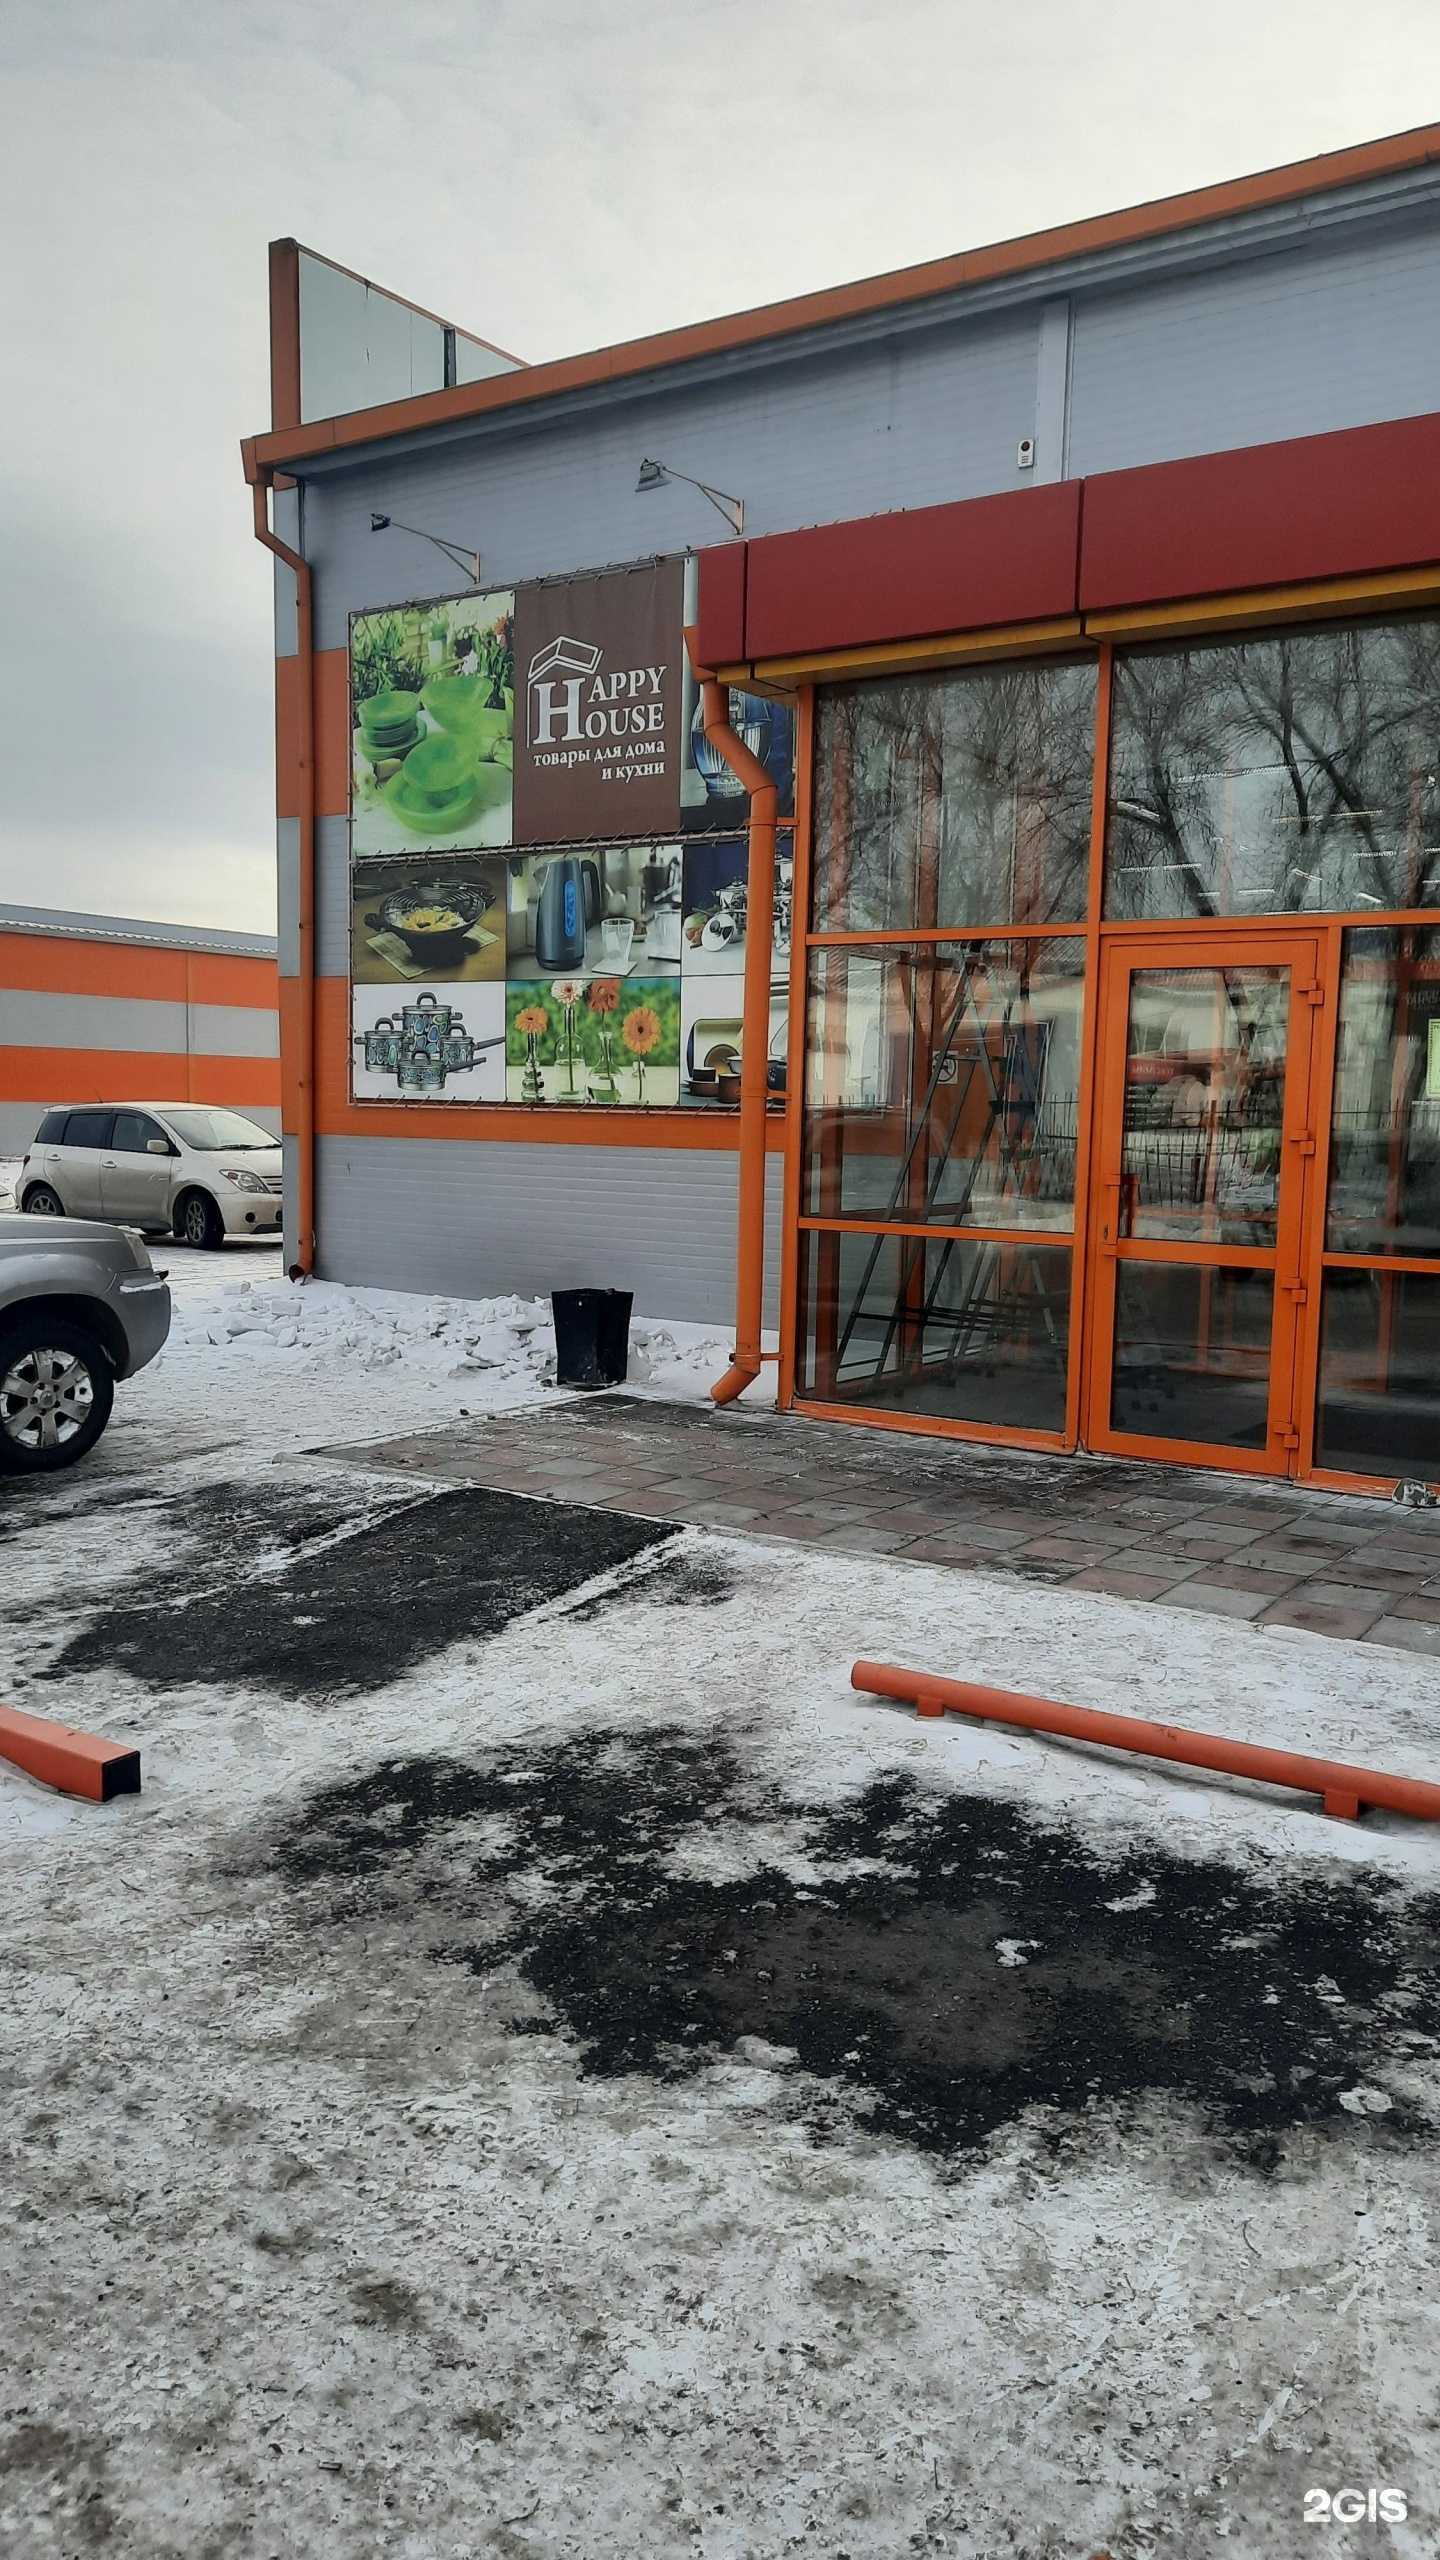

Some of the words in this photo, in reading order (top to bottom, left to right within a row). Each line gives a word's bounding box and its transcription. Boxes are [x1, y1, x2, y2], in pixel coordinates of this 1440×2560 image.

[534, 749, 590, 768] товары
[593, 745, 622, 763] для
[626, 740, 665, 759] дома
[602, 767, 612, 780] и
[616, 762, 665, 783] кухни
